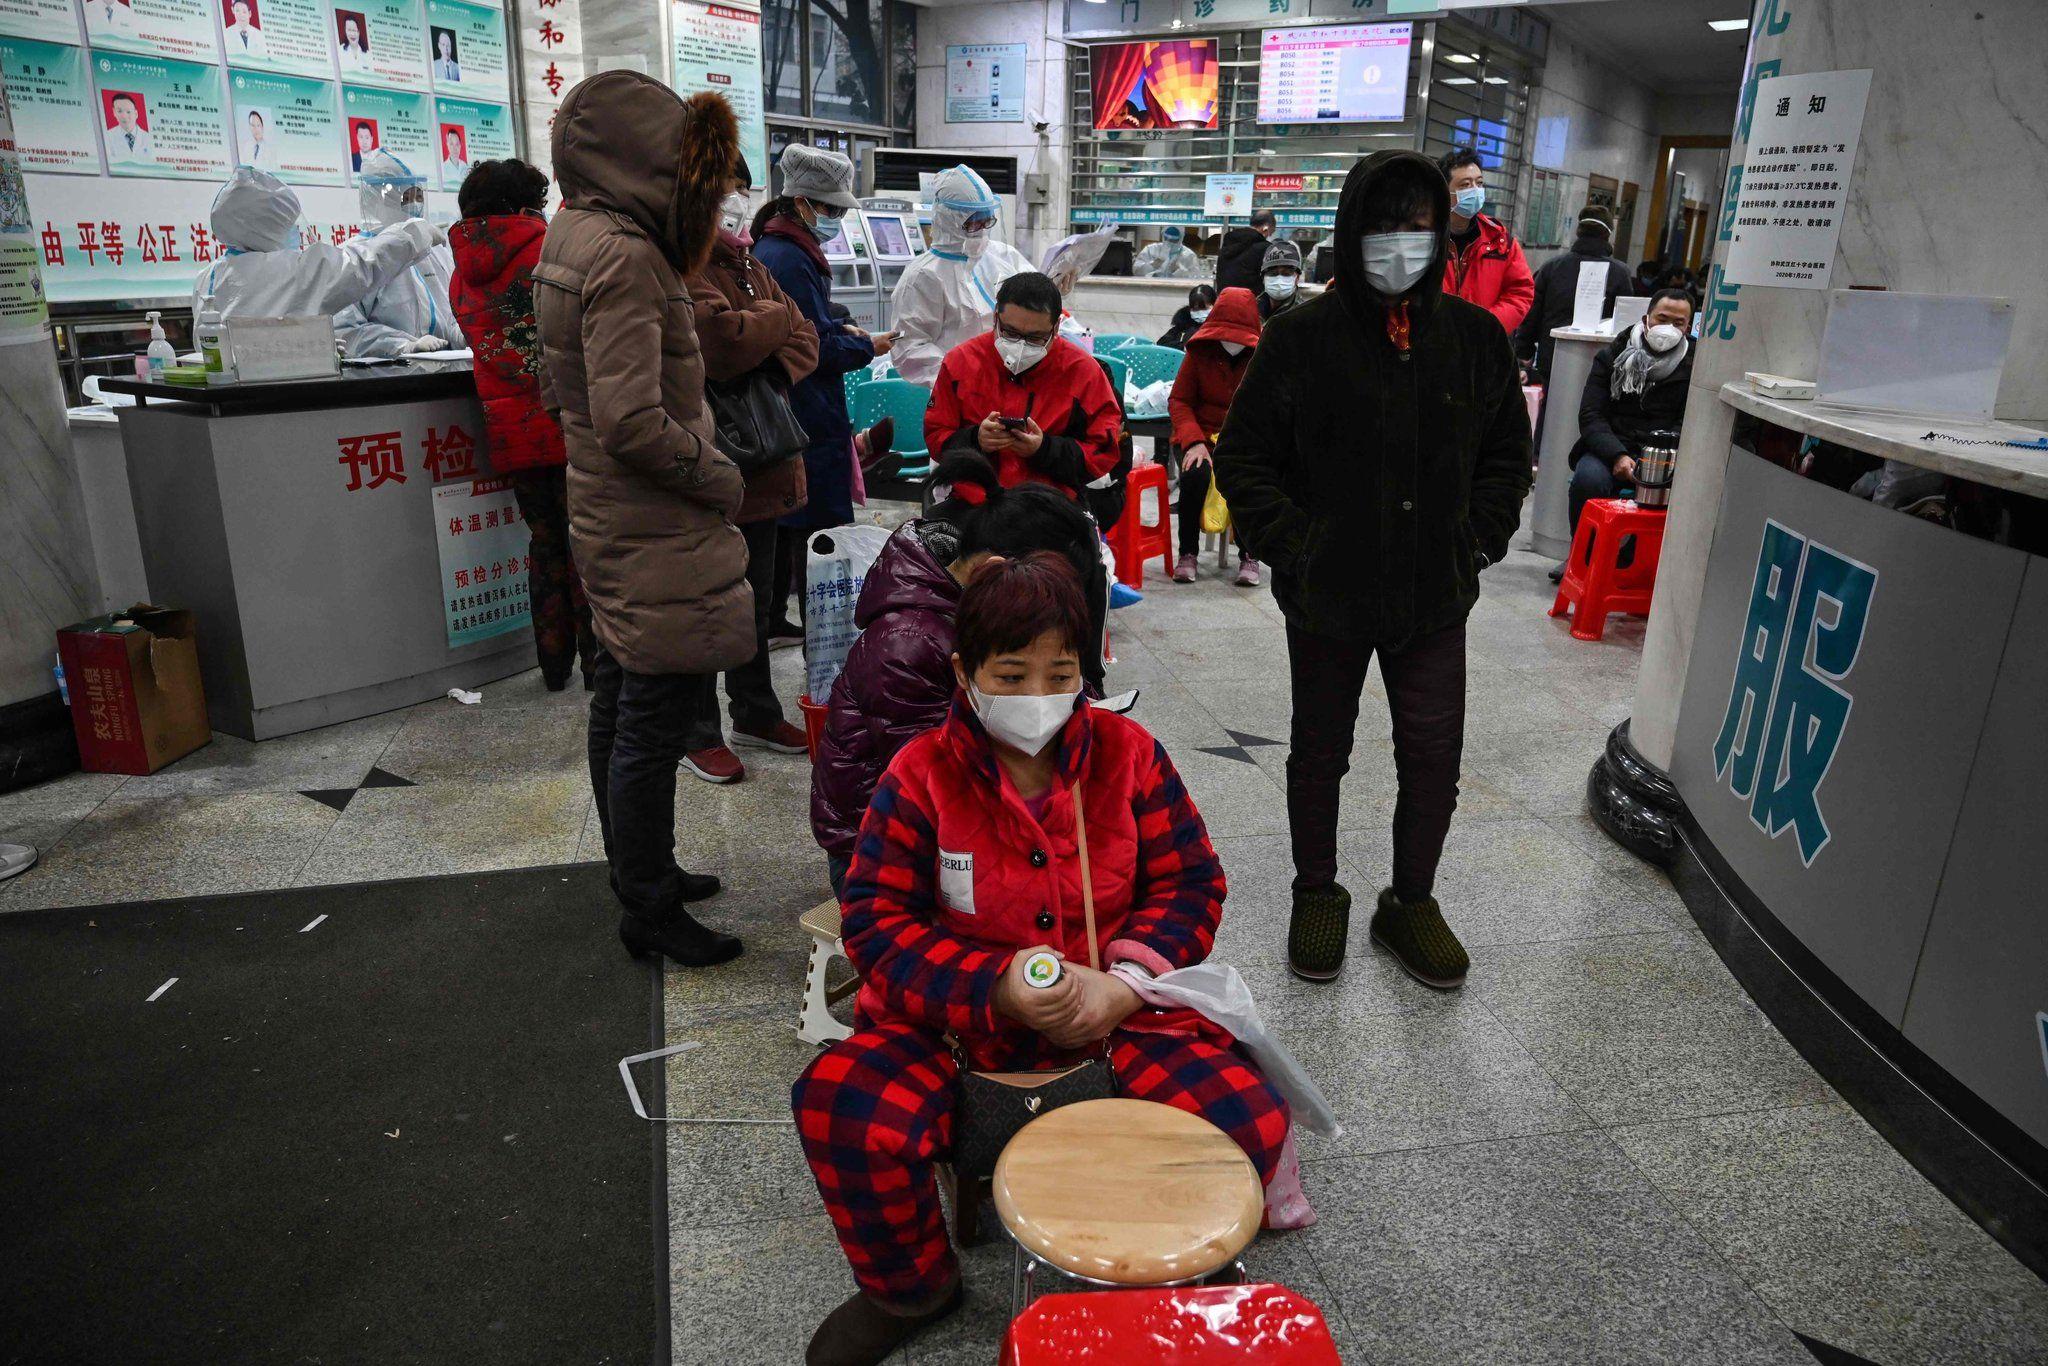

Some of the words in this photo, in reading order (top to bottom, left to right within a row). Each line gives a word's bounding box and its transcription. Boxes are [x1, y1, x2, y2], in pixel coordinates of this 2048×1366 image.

[1775, 94, 1827, 117] 通知
[76, 221, 124, 266] 平等
[136, 223, 181, 263] 公正
[337, 425, 480, 493] 预检
[84, 666, 113, 741] 农夫山泉
[101, 667, 117, 705] SPRING
[1712, 517, 1879, 869] 服
[109, 705, 125, 741] NONGFU
